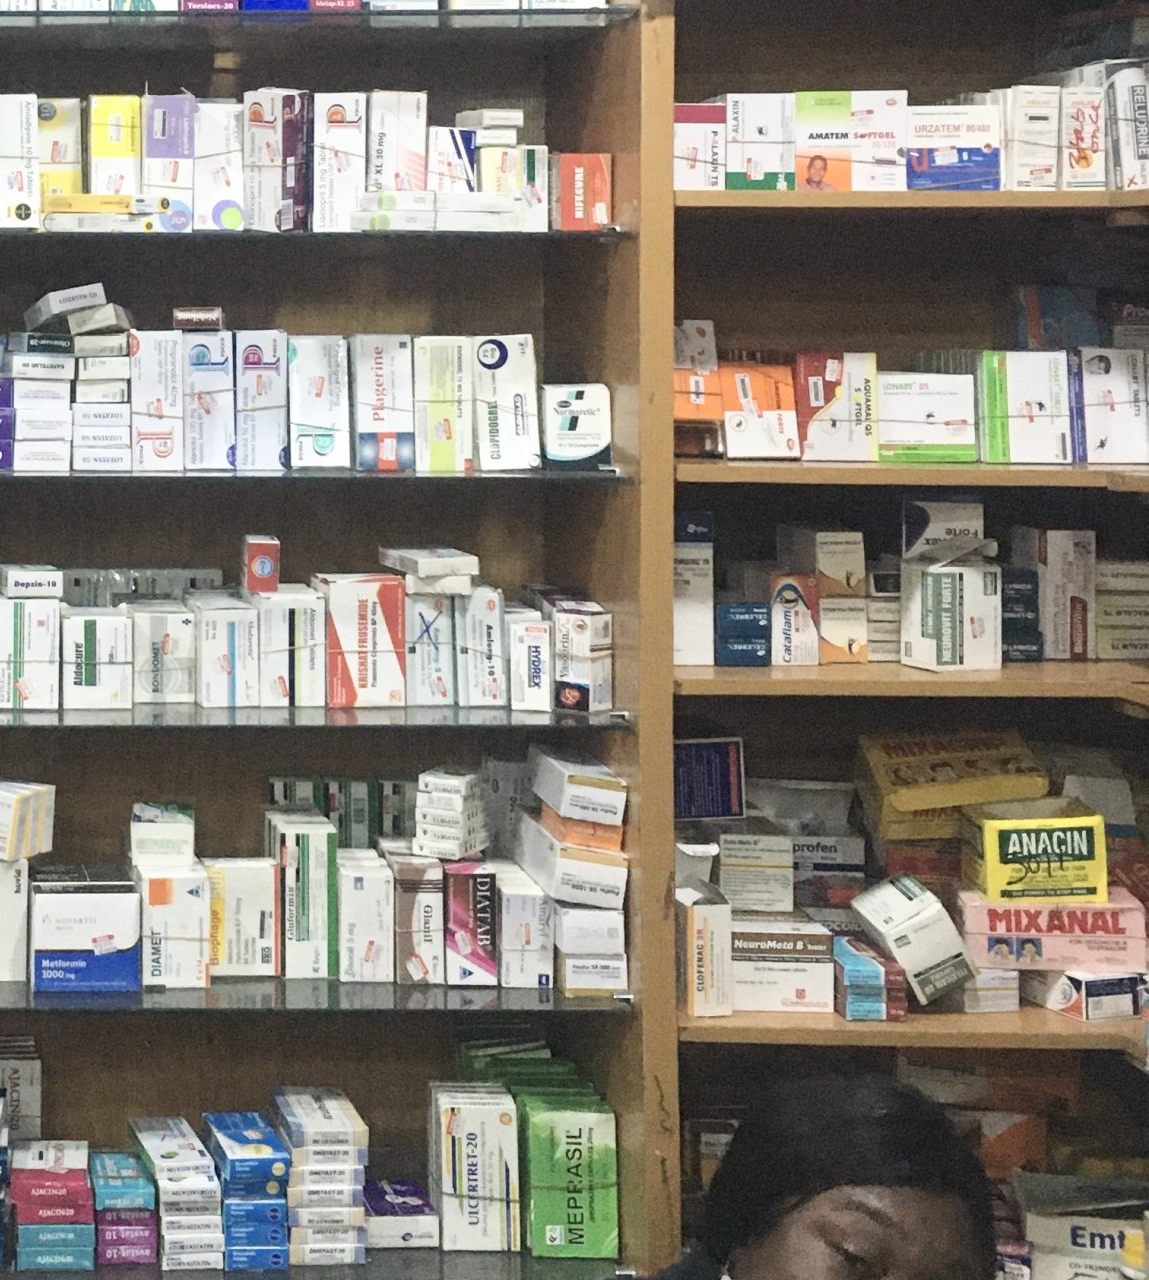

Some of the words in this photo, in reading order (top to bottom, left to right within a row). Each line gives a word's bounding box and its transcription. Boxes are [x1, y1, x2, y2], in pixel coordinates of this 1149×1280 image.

[808, 131, 849, 140] AMATEM
[914, 124, 962, 134] URZATEM
[574, 166, 583, 219] NIFECURE
[372, 346, 384, 422] Plagerine
[942, 576, 952, 620] FORTE
[782, 609, 793, 664] Cataflam
[942, 621, 952, 665] NEUROVIT
[73, 641, 84, 686] Aldocure
[532, 645, 541, 688] HYDREX
[1007, 830, 1089, 857] ANACIN
[476, 876, 492, 947] DIATAB
[988, 908, 1127, 935] MIXANAL
[41, 958, 87, 968] Metformin
[150, 929, 162, 977] DIAMET
[734, 939, 793, 950] NeuroMeta
[794, 940, 803, 950] B
[41, 970, 64, 979] 1000
[696, 942, 704, 993] CLOFENAC
[568, 1127, 585, 1245] MEPRASIL
